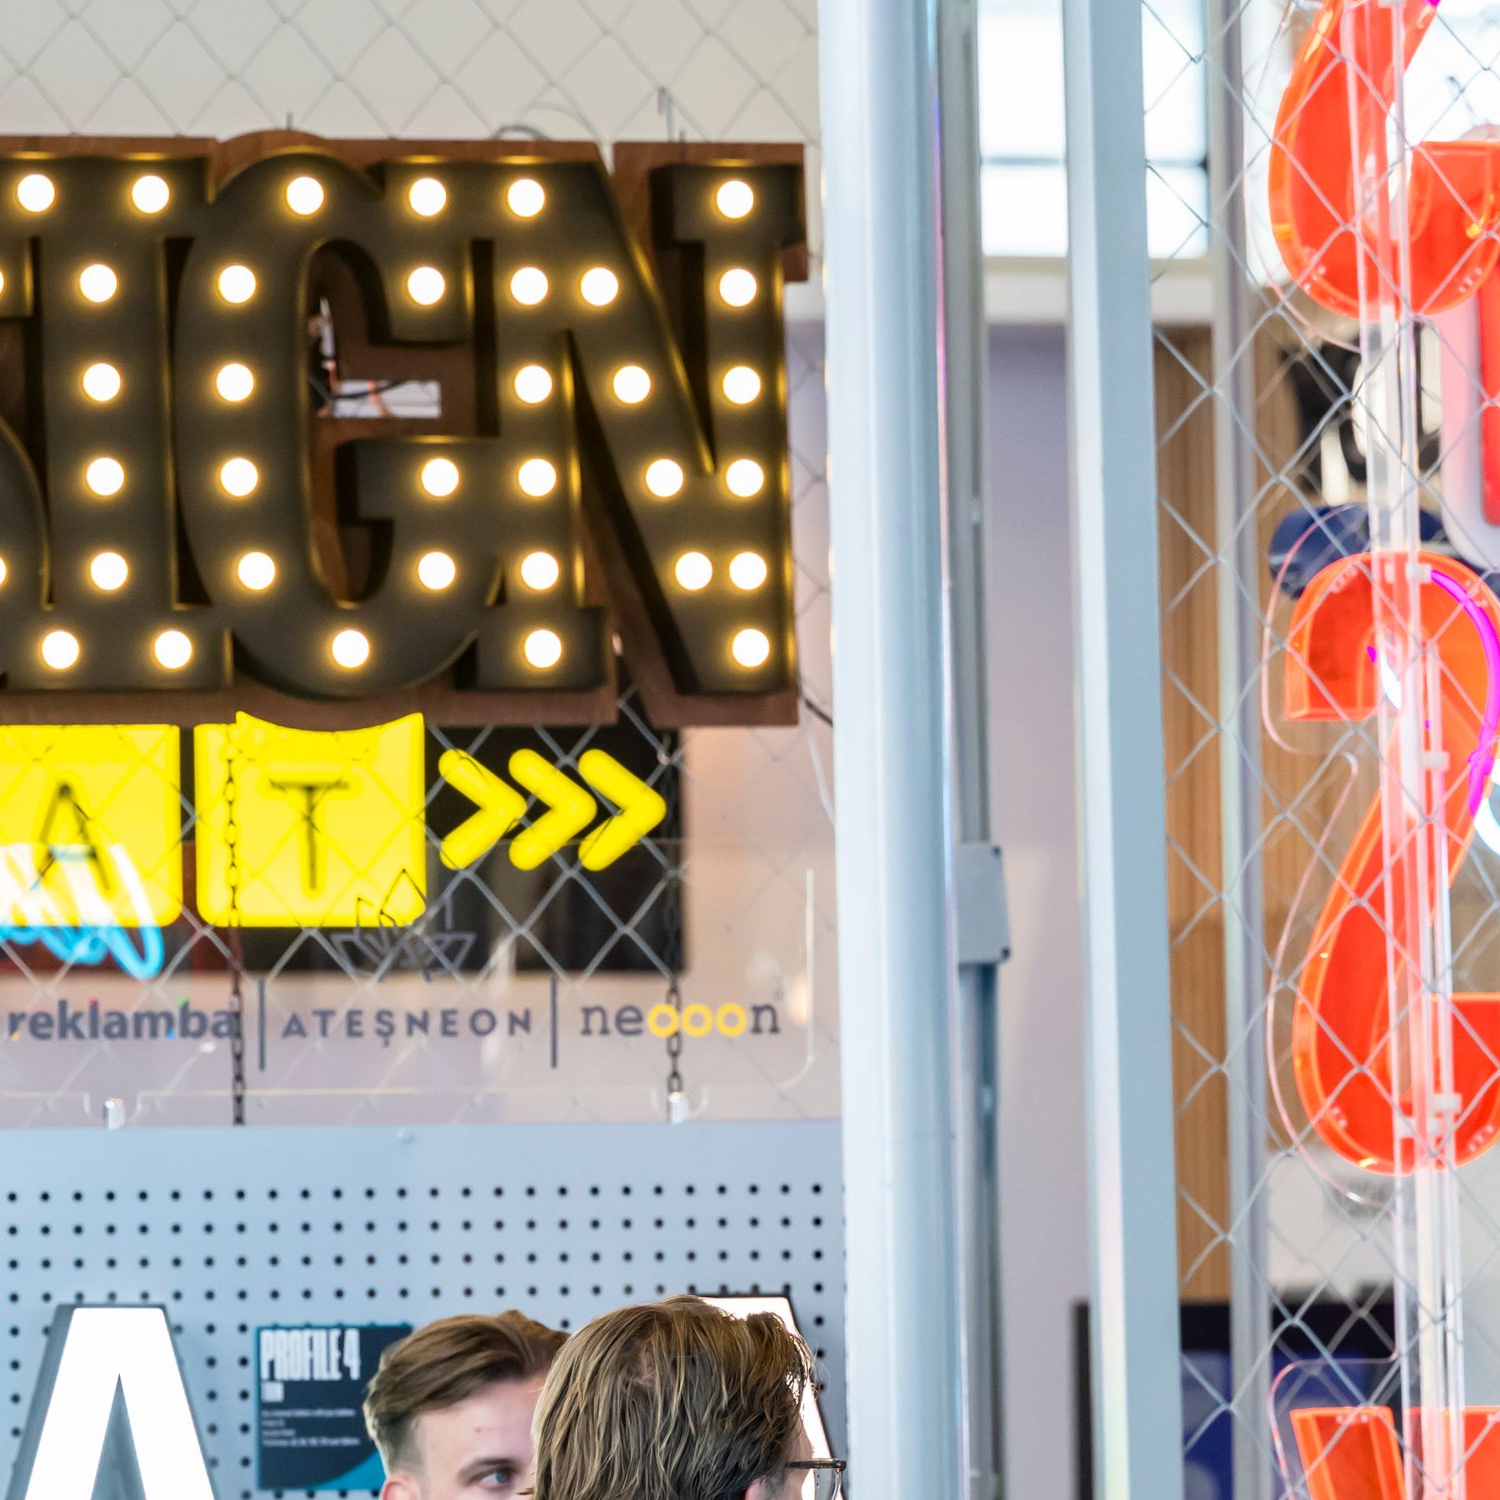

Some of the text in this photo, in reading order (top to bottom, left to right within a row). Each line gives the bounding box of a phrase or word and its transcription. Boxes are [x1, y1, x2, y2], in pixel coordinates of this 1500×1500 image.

[7, 999, 238, 1041] reklamba
[280, 1006, 533, 1048] ATEŞNEON
[579, 1002, 781, 1038] neooon
[260, 1327, 361, 1381] PROFILE 4
